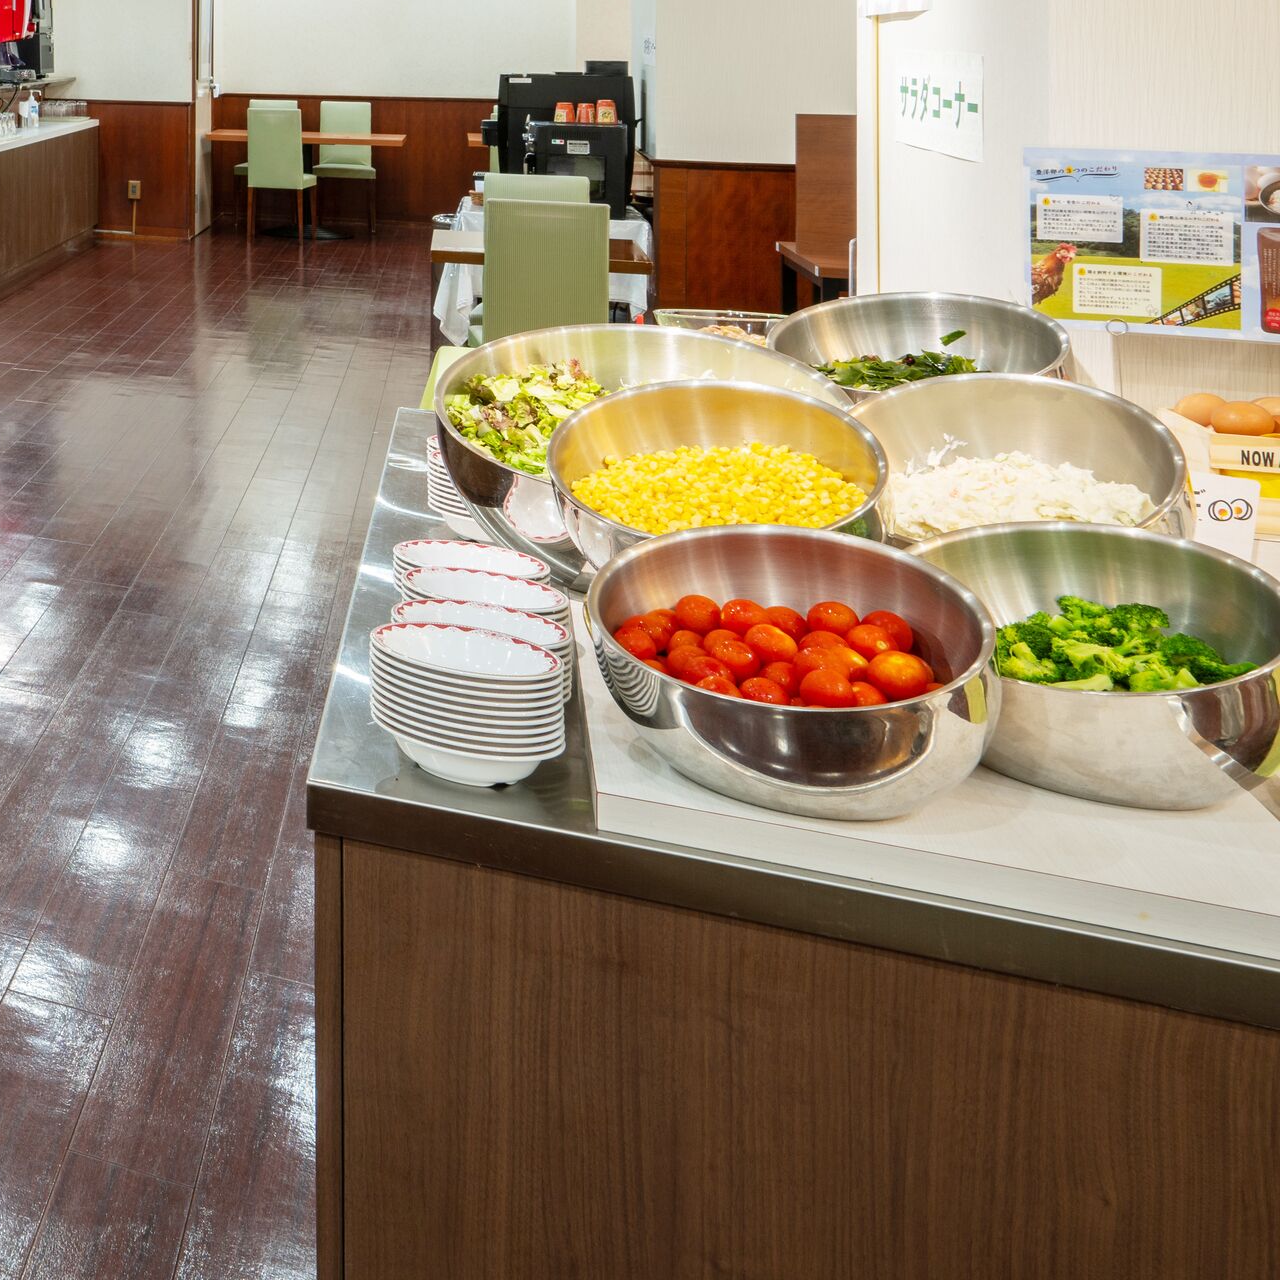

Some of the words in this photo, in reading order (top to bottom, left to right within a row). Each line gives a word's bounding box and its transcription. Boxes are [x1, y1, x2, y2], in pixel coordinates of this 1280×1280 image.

[900, 74, 979, 129] サラダコーナー
[1241, 449, 1275, 468] NOW
